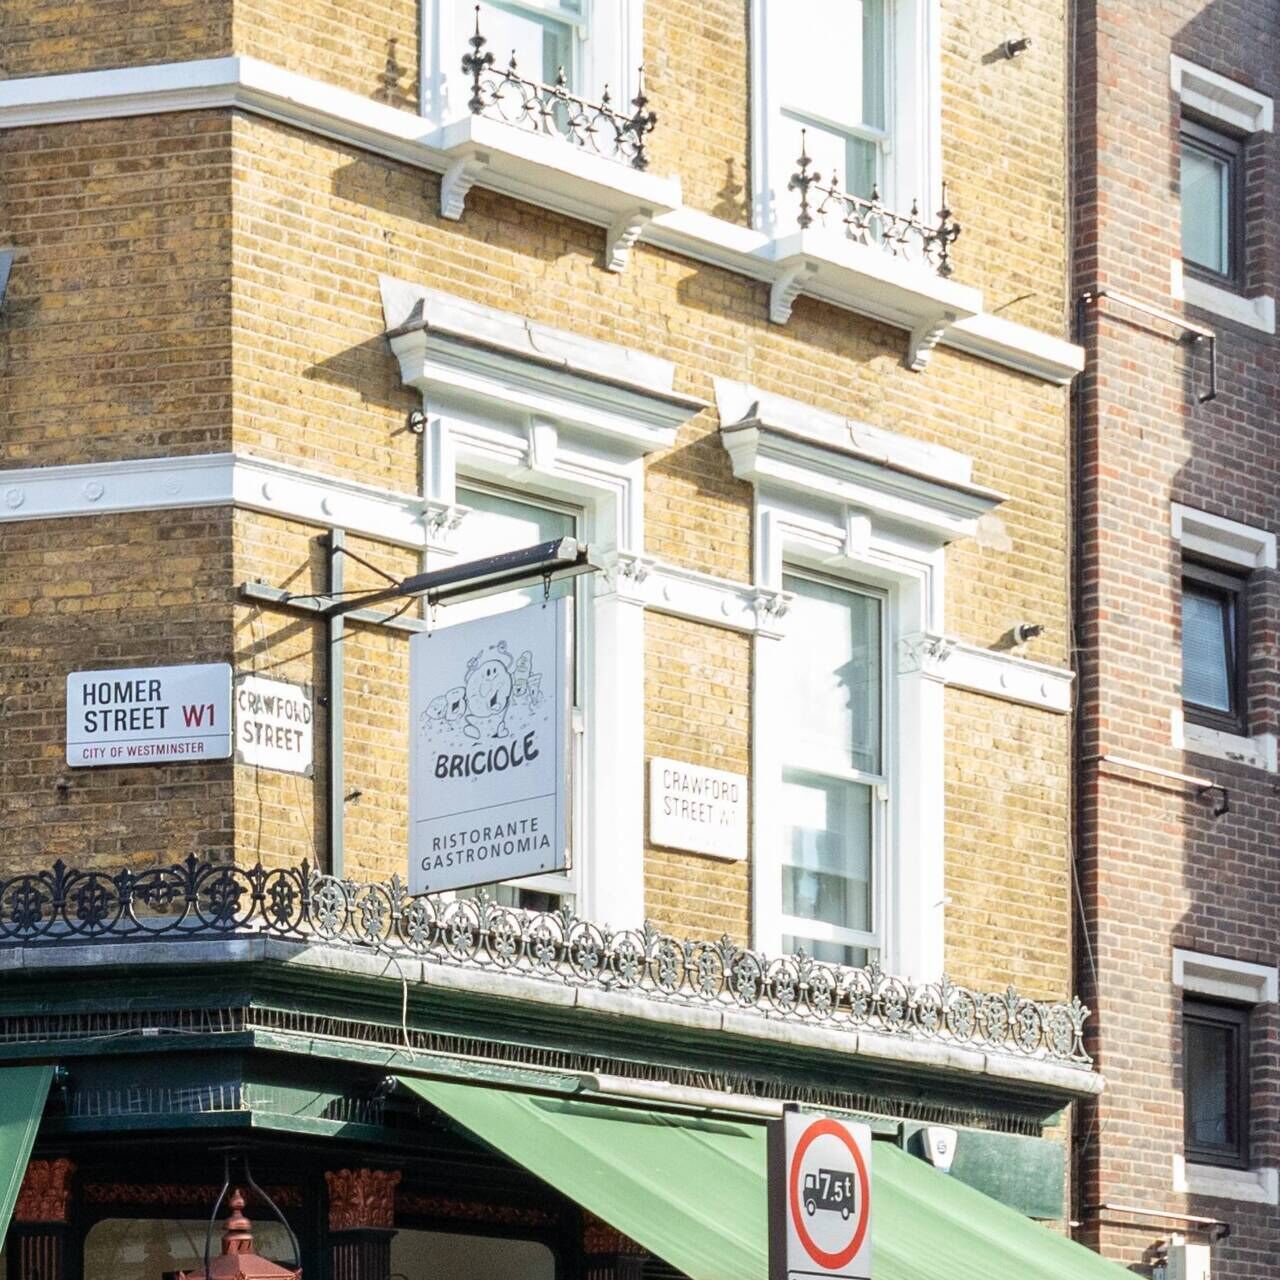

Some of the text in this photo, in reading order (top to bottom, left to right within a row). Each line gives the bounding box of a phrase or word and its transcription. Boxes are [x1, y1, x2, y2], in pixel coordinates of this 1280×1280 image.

[83, 679, 162, 706] HOMER
[238, 689, 312, 725] CRAWFORD
[84, 704, 215, 733] STREET W1
[82, 742, 205, 759] CITY OF WESTMINSTER
[242, 720, 304, 753] STREET
[434, 730, 540, 779] BRICIOLE
[663, 768, 739, 803] CRAWFORD
[663, 795, 714, 824] STREET
[432, 816, 539, 852] RISTORANTE
[421, 834, 551, 871] GASTRONOMIA
